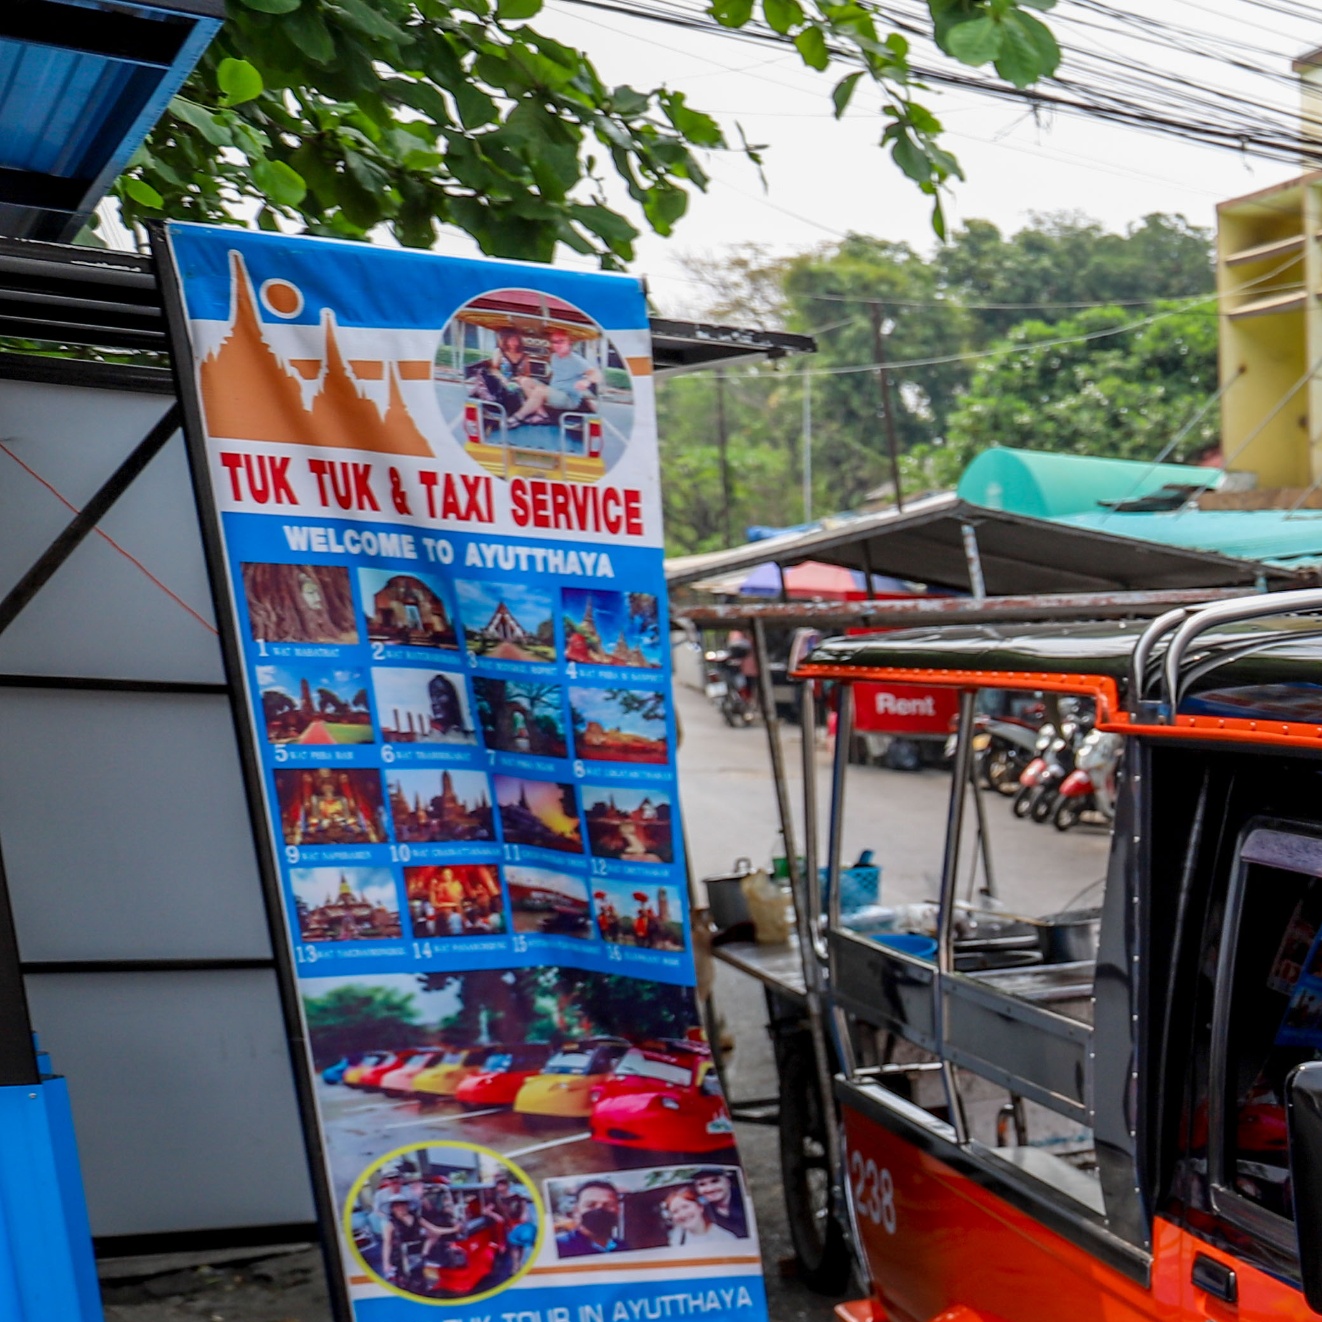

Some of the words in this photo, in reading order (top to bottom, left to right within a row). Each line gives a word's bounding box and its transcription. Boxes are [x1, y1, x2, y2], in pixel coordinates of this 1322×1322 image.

[220, 452, 300, 505] TUK
[308, 459, 381, 511] TUK
[389, 466, 413, 516] &
[418, 470, 495, 523] TAXI
[510, 478, 644, 536] SERVICE
[282, 525, 418, 560] WELCOME
[422, 537, 455, 565] TO
[465, 542, 615, 578] AYUTTHAYA
[372, 641, 386, 660] 2
[565, 662, 578, 679] 4
[875, 691, 936, 716] Rent
[274, 744, 289, 762] 5
[381, 744, 395, 763] 6
[285, 845, 300, 864] 9
[389, 844, 411, 862] 10
[296, 944, 319, 963] 13
[412, 941, 433, 960] 14
[852, 1149, 896, 1234] 238
[612, 1286, 753, 1322] AYUTTHAYA
